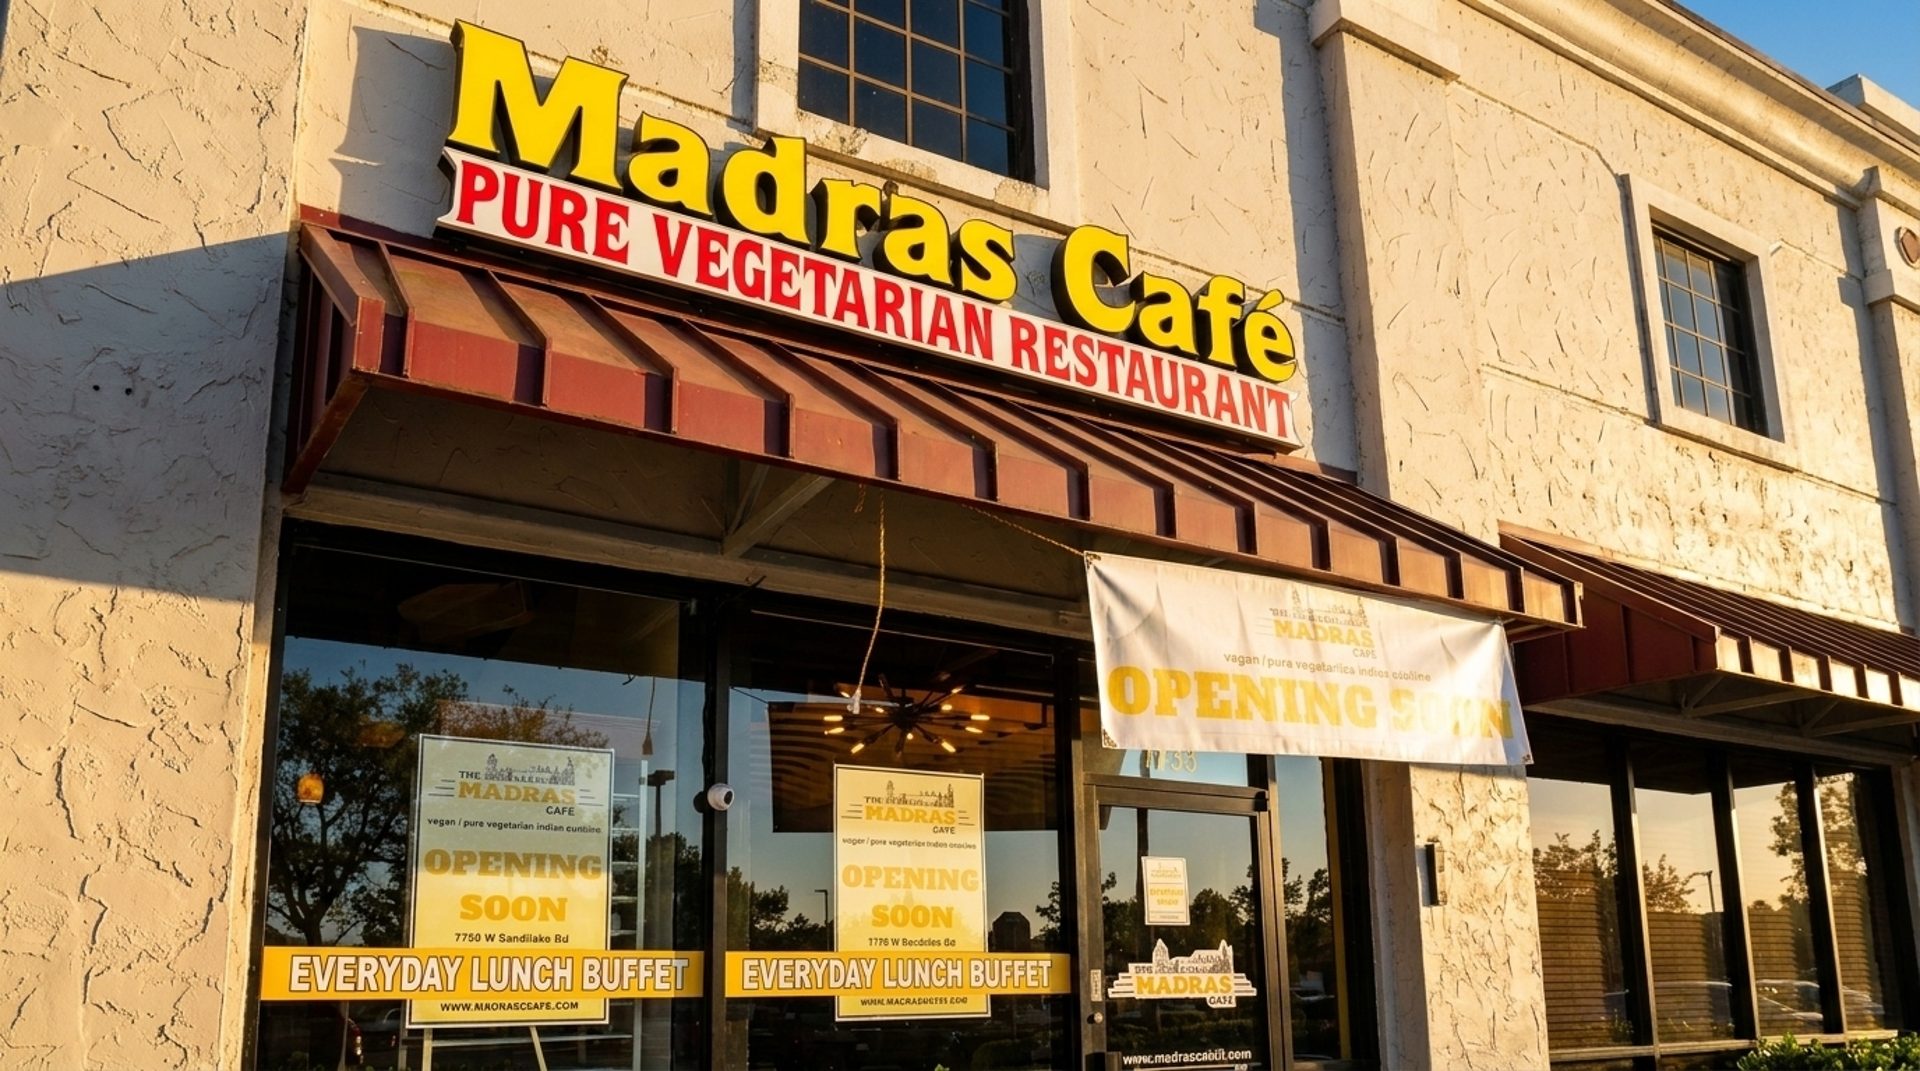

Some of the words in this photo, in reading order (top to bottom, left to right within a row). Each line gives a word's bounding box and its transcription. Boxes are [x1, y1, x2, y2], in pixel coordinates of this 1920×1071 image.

[447, 18, 1017, 302] Madras
[1054, 225, 1297, 382] Café
[454, 159, 630, 264] PURE
[653, 218, 996, 362] VEGETARIAN
[1009, 315, 1293, 440] RESTAURANT
[1273, 618, 1375, 648] MADRAS
[1106, 665, 1378, 728] OPENING
[458, 770, 481, 781] THE
[458, 781, 576, 804] MADRAS
[545, 805, 576, 816] CAFE
[864, 804, 956, 825] MADRAS
[427, 817, 456, 827] vegan
[463, 820, 485, 829] pure
[486, 821, 534, 831] vegetarian
[536, 821, 565, 832] indian
[423, 848, 602, 880] OPENING
[841, 863, 980, 892] OPENING
[459, 894, 568, 922] SOON
[871, 903, 955, 929] SOON
[454, 933, 482, 943] 7750
[485, 933, 496, 943] W
[891, 937, 901, 947] W
[288, 954, 464, 993] EVERYDAY
[470, 955, 574, 992] LUNCH
[581, 957, 690, 992] BUFFET
[742, 957, 877, 991] EVERYDAY
[882, 958, 964, 989] LUNCH
[969, 958, 1053, 989] BUFFET
[1135, 975, 1233, 995] MADRAS
